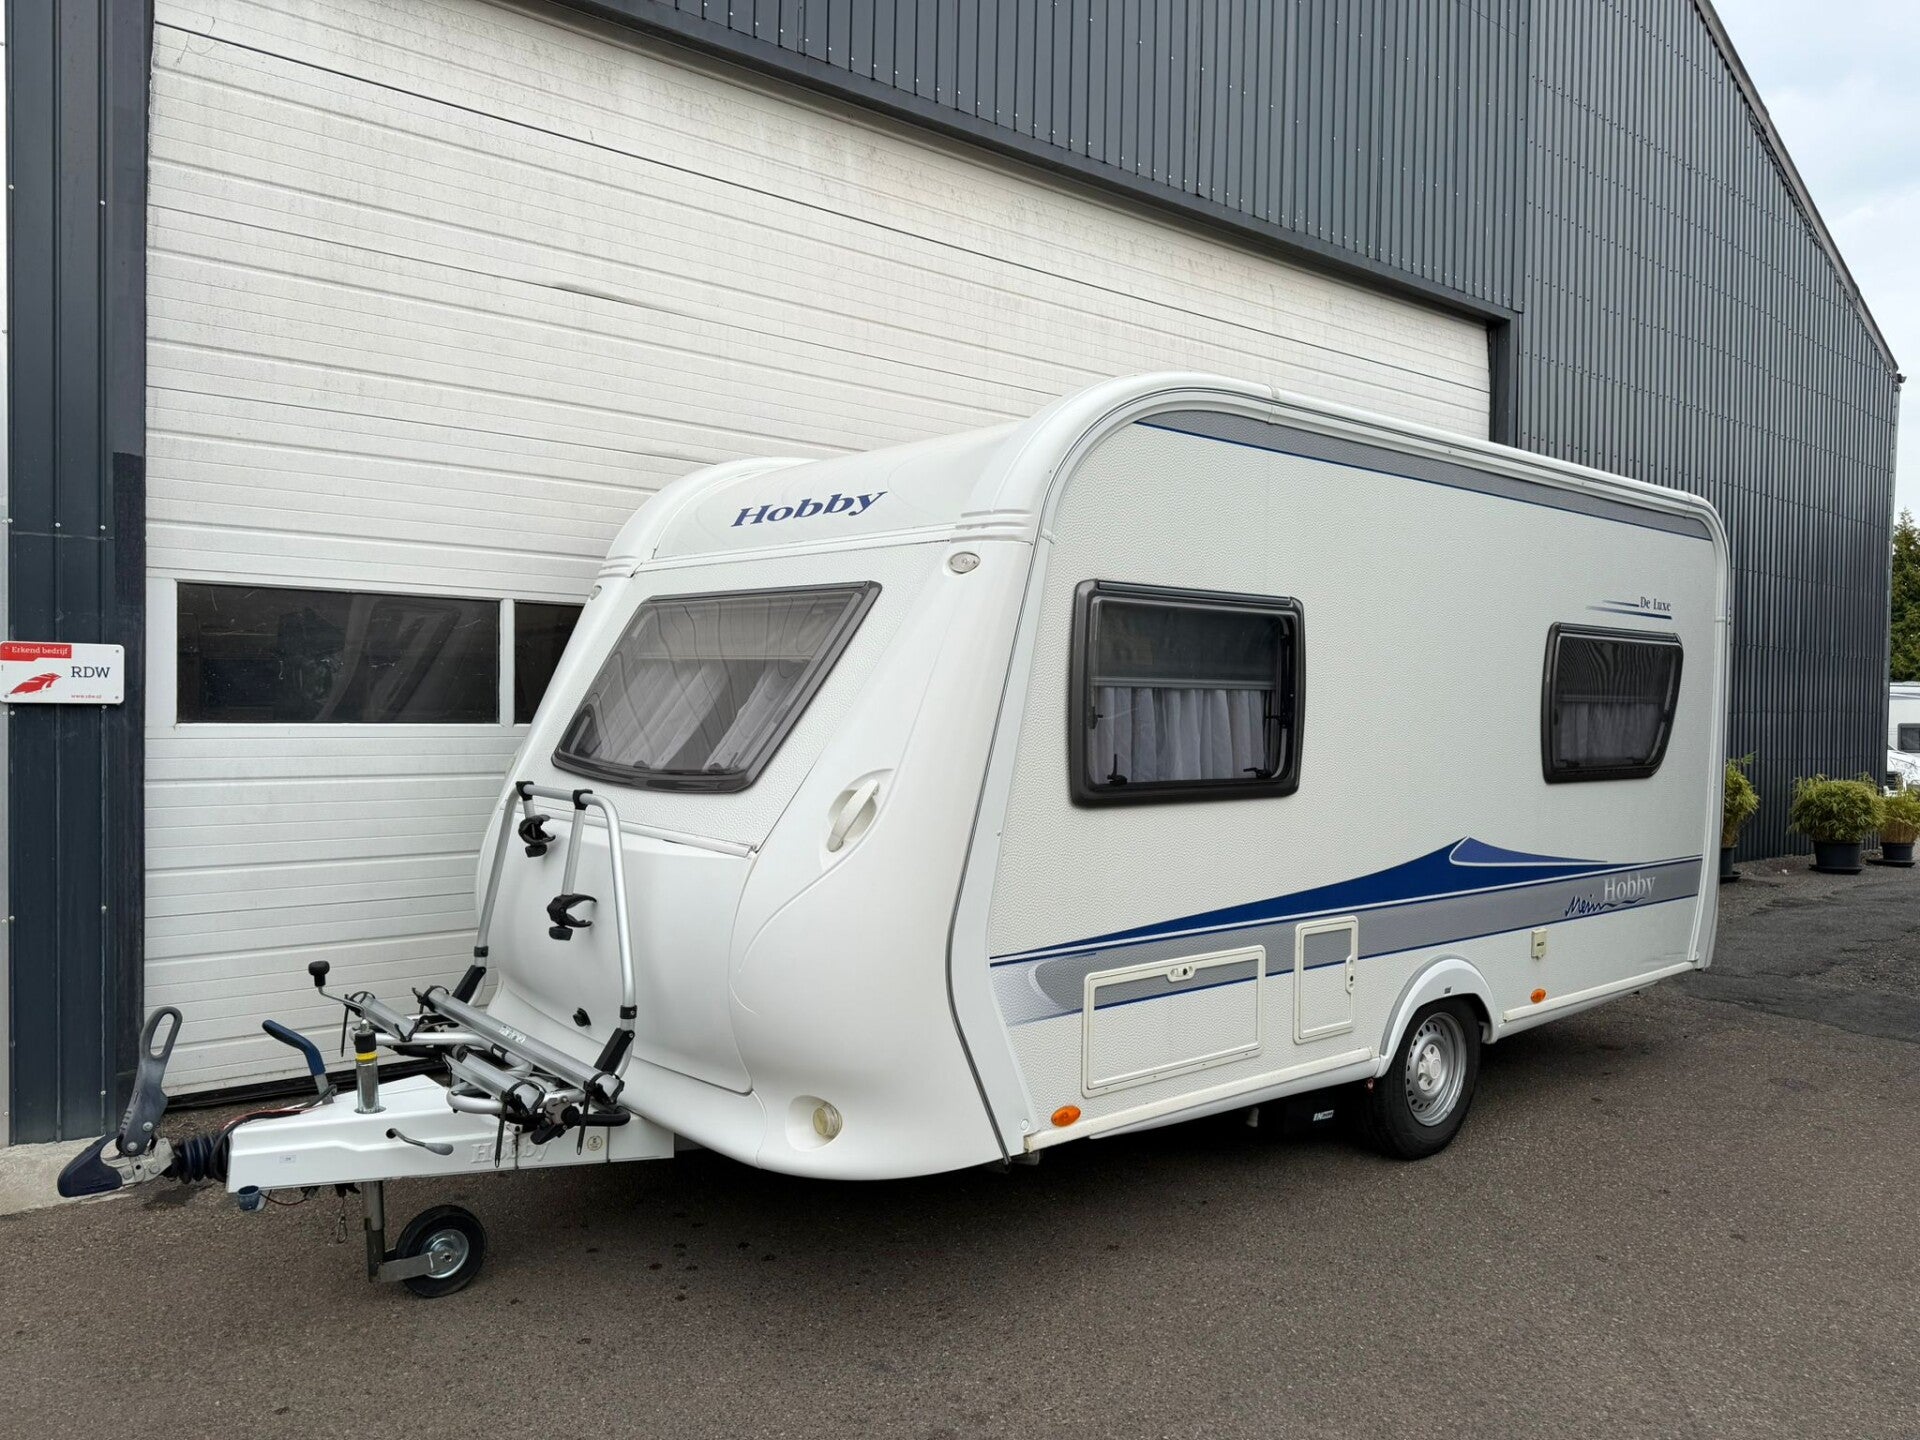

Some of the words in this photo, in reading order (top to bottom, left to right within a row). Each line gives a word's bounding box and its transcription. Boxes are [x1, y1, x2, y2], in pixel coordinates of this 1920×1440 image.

[731, 490, 888, 527] Hobby
[1640, 596, 1651, 609] De
[1653, 598, 1671, 612] Luxe
[11, 646, 40, 654] Erkend
[42, 647, 68, 656] bedrijf
[70, 666, 110, 678] RDW
[1565, 894, 1618, 917] Mein
[1603, 873, 1656, 902] Hobby
